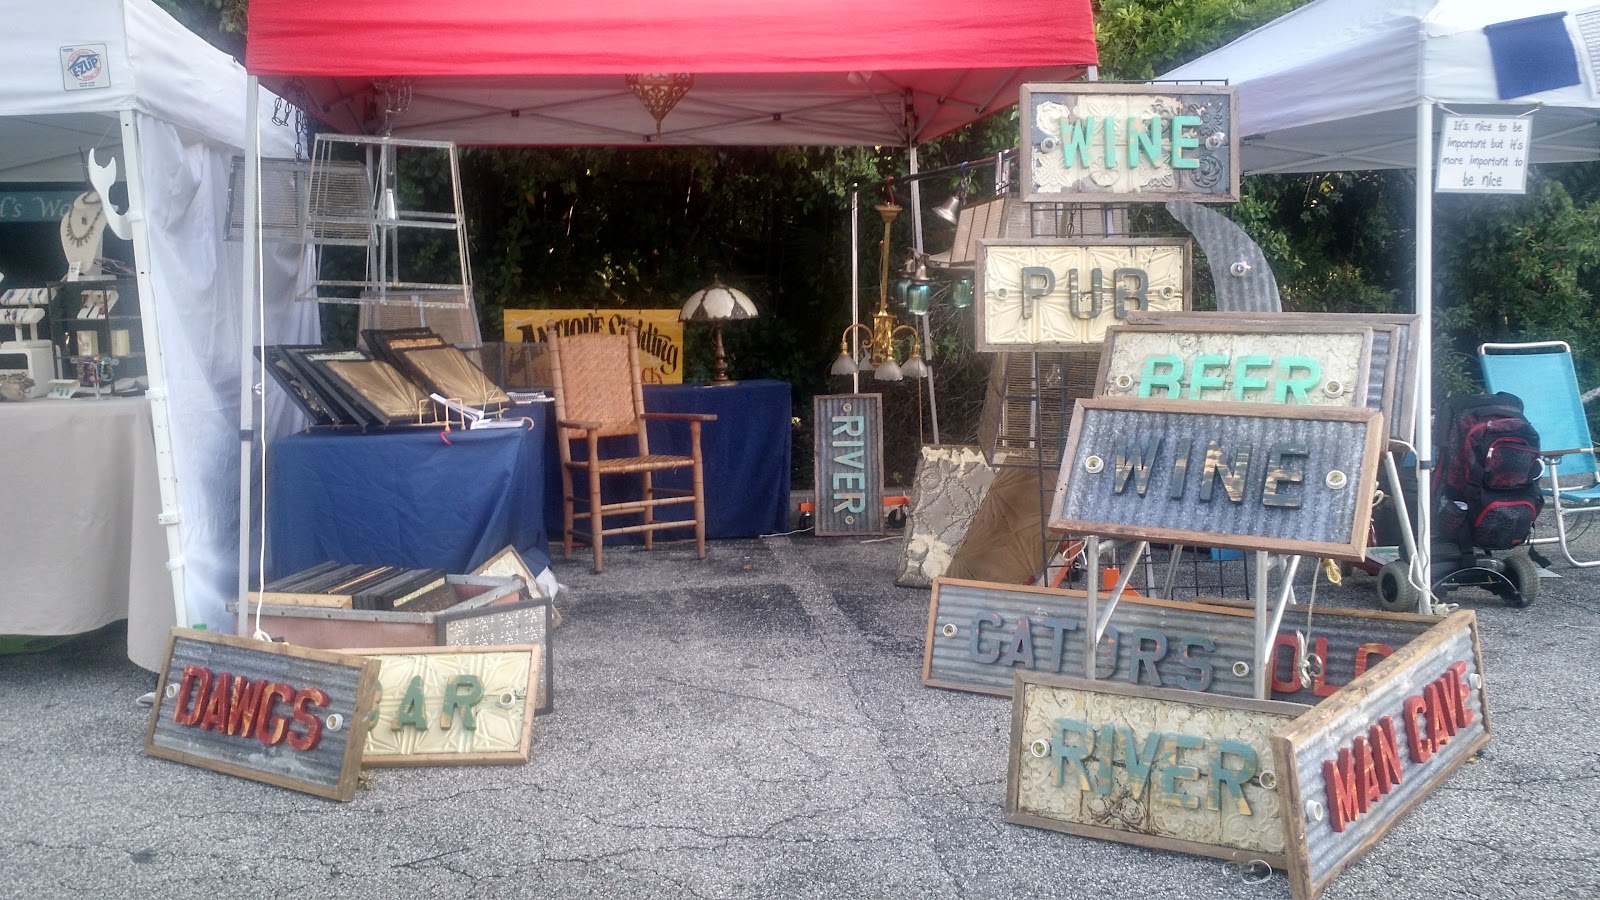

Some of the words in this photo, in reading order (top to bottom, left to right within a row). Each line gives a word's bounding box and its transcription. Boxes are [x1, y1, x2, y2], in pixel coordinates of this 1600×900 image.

[1059, 115, 1201, 169] WINE
[1447, 137, 1486, 151] important
[1491, 138, 1503, 149] but
[1510, 138, 1523, 150] it's
[1453, 119, 1469, 131] It's
[1475, 120, 1492, 131] nice
[1498, 123, 1507, 132] to
[1513, 122, 1522, 132] be
[1442, 156, 1463, 165] more
[1470, 155, 1508, 168] important
[1515, 157, 1523, 166] to
[1463, 171, 1474, 187] be
[1482, 172, 1502, 187] nice
[1022, 266, 1149, 320] PUB
[832, 415, 865, 513] RIVER
[1114, 436, 1310, 509] WINE
[173, 666, 330, 752] DAWGS
[1050, 717, 1258, 815] RIVER
[1324, 715, 1402, 832] MAN
[1404, 661, 1473, 763] CAVE
